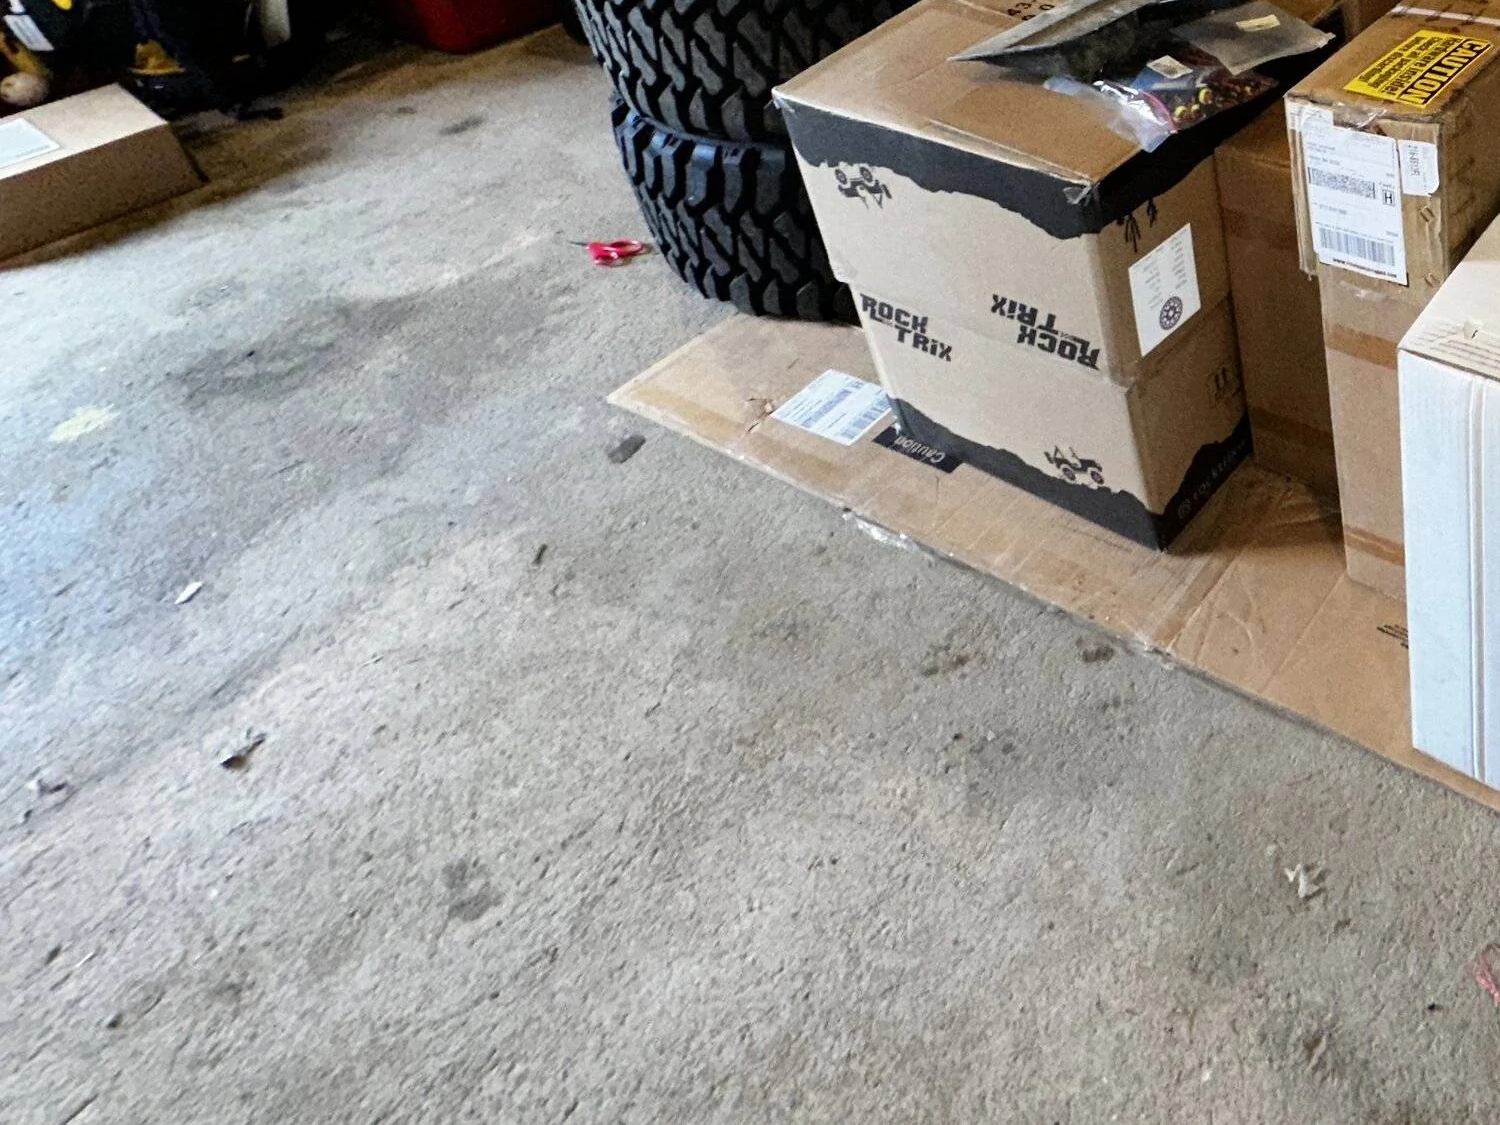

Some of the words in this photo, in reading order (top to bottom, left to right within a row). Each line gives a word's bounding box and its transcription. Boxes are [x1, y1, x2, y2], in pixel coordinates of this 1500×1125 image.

[1400, 39, 1488, 104] CAUTION
[860, 292, 929, 334] ROCK
[1016, 325, 1101, 371] ROCK
[893, 433, 946, 464] Caution
